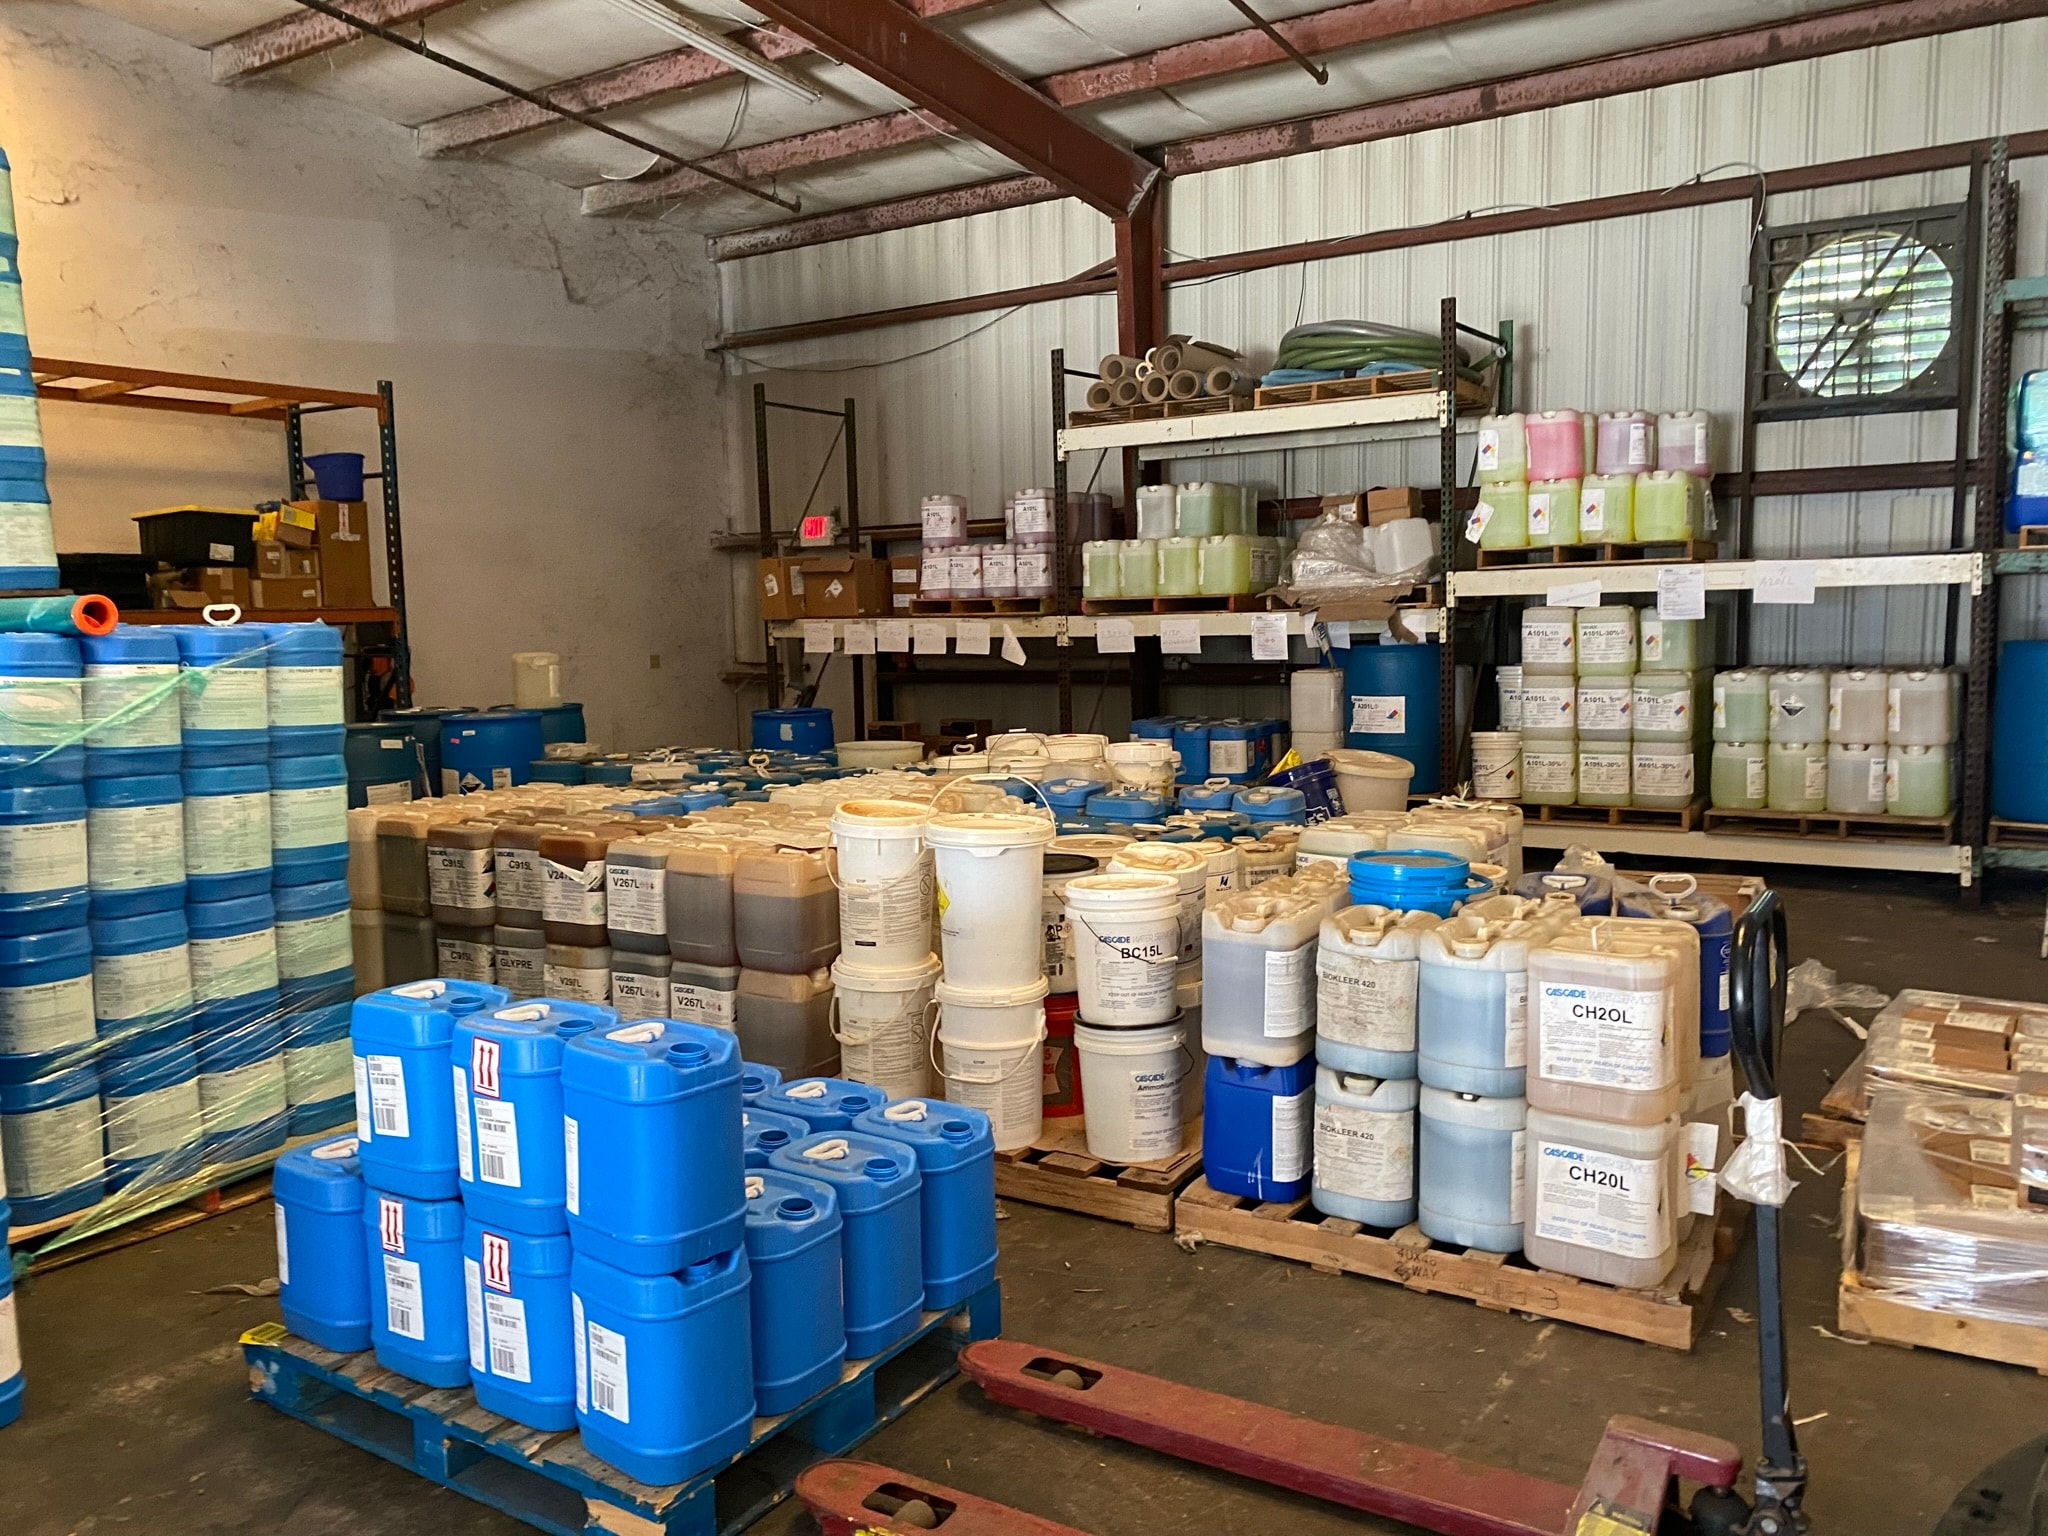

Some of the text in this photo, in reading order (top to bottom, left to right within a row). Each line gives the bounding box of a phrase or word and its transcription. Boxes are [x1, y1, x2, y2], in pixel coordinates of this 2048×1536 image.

[1583, 696, 1606, 704] A101L
[1637, 696, 1660, 704] A101L
[442, 859, 465, 869] C915L
[509, 860, 533, 871] C915L
[612, 877, 640, 889] V267L
[1100, 935, 1131, 943] CASCADE
[450, 951, 474, 962] C915L
[1121, 945, 1163, 959] BC15L
[500, 958, 533, 969] GLYPRE
[559, 977, 582, 988] V297L
[1322, 971, 1376, 988] BIOKLEER 420
[619, 984, 646, 997] V267L
[1546, 988, 1586, 998] CASCADE
[677, 996, 705, 1009] V267L
[1135, 1073, 1165, 1083] CASCADE
[1320, 1123, 1374, 1140] BIOKLEER 420
[1544, 1147, 1584, 1161] CASCADE
